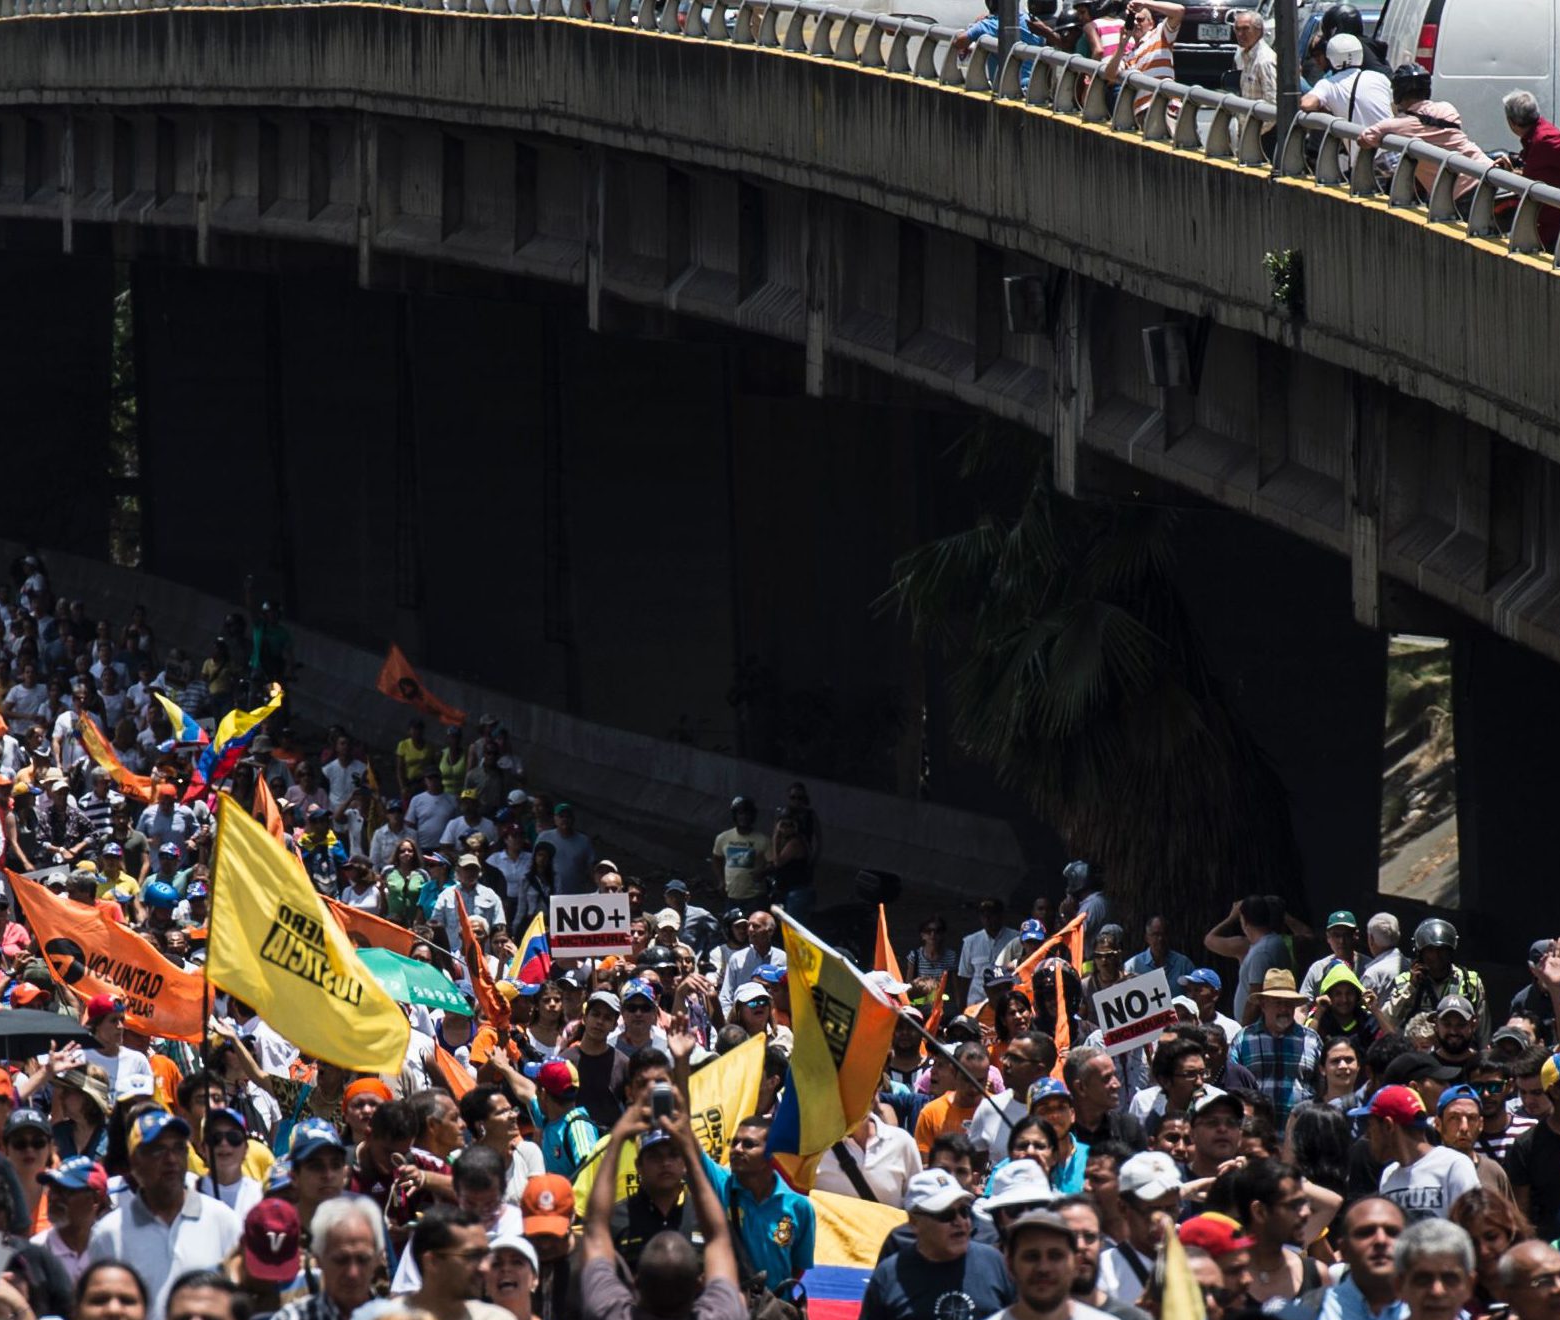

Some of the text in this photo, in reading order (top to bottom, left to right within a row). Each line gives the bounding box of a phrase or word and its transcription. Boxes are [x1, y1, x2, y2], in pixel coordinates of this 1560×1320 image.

[556, 904, 626, 932] NO+
[86, 952, 164, 999] VOLUNTAD
[1101, 987, 1167, 1029] NO+
